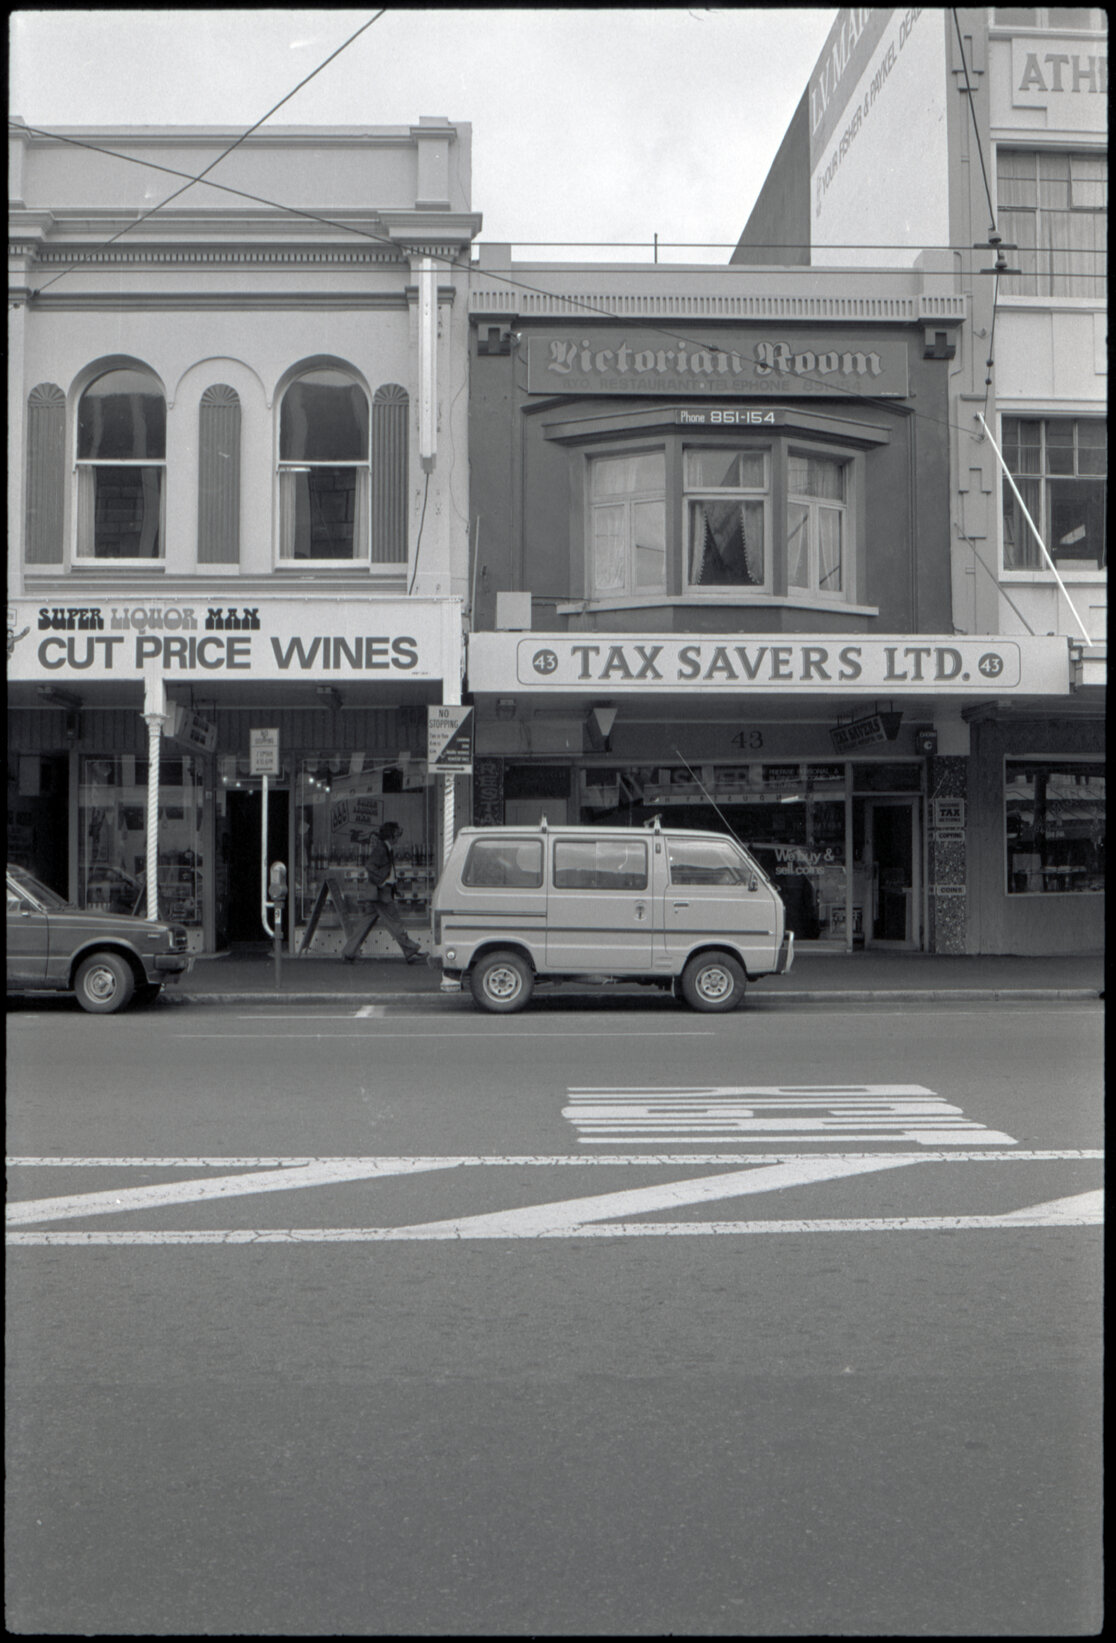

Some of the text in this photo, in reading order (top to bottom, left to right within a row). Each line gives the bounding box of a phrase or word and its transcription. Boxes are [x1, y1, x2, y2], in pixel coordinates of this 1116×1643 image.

[821, 150, 838, 195] YOUR
[839, 104, 863, 164] FISHER
[863, 92, 869, 117] &
[870, 41, 898, 106] PAYKEL
[548, 340, 882, 376] Victorian Room
[600, 379, 698, 391] RESTAURANT
[708, 380, 791, 392] TELEPHONE
[680, 410, 775, 424] Phone 851-154
[38, 608, 261, 635] SUPER LIQUOR MAN
[39, 636, 419, 670] CUT PRICE WINES
[533, 645, 1001, 682] 43 TAX SAVERS LTD. 43
[439, 709, 450, 718] NO
[429, 719, 459, 729] STOPPING
[731, 731, 764, 750] 43
[940, 809, 960, 817] TAX
[776, 849, 796, 862] We
[824, 848, 835, 862] &
[776, 862, 825, 875] sell coins
